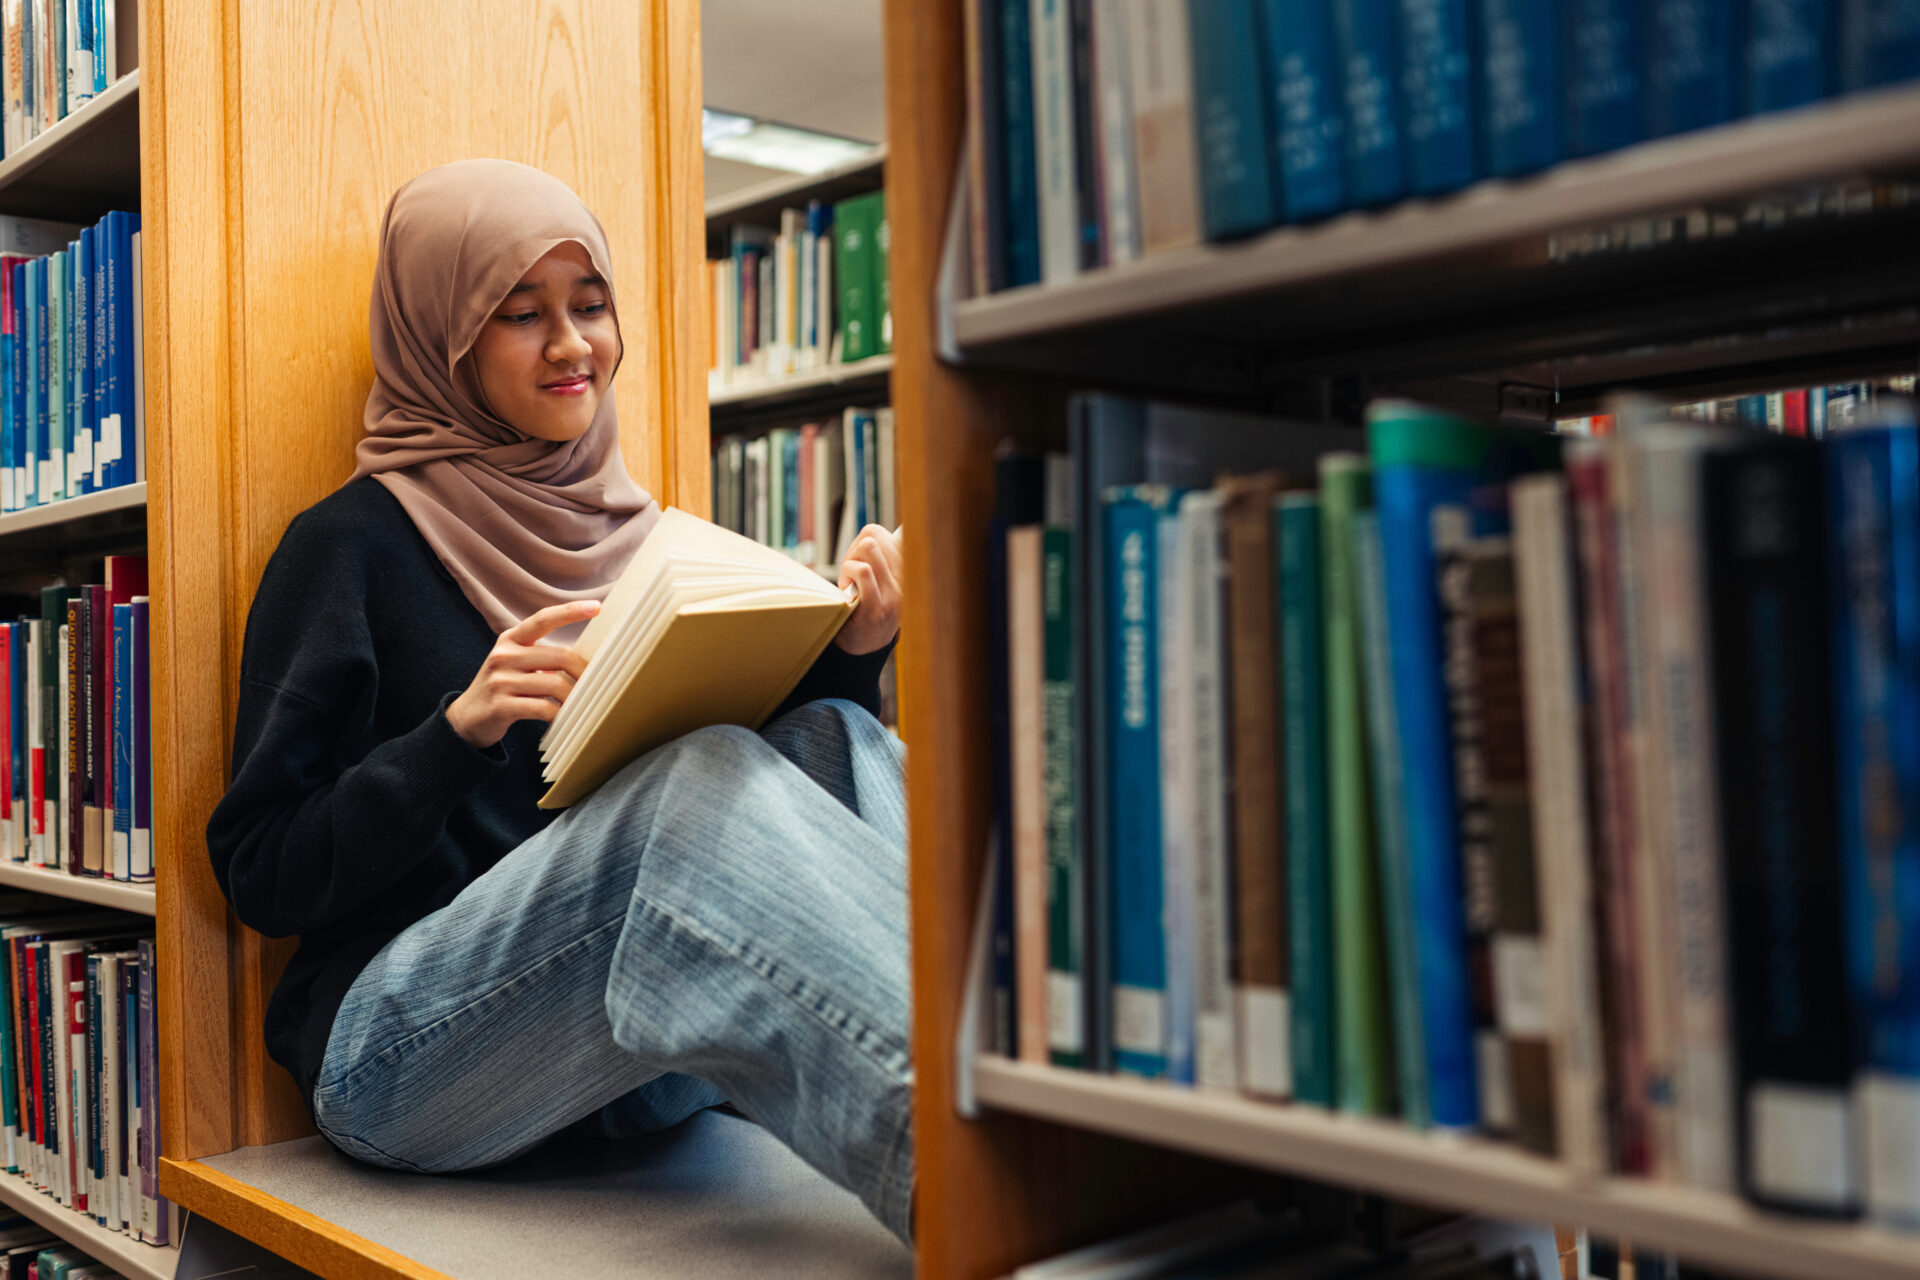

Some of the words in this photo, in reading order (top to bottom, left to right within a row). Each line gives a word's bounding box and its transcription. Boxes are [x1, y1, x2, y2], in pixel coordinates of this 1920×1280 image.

[67, 609, 77, 672] QUALITATIVE
[68, 673, 76, 719] RESEARCH
[68, 719, 76, 738] FOR
[68, 740, 77, 774] NURSES
[45, 1015, 54, 1088] MANAGED
[50, 1092, 58, 1132] CARE
[103, 1083, 109, 1094] to
[104, 1097, 110, 1116] RN
